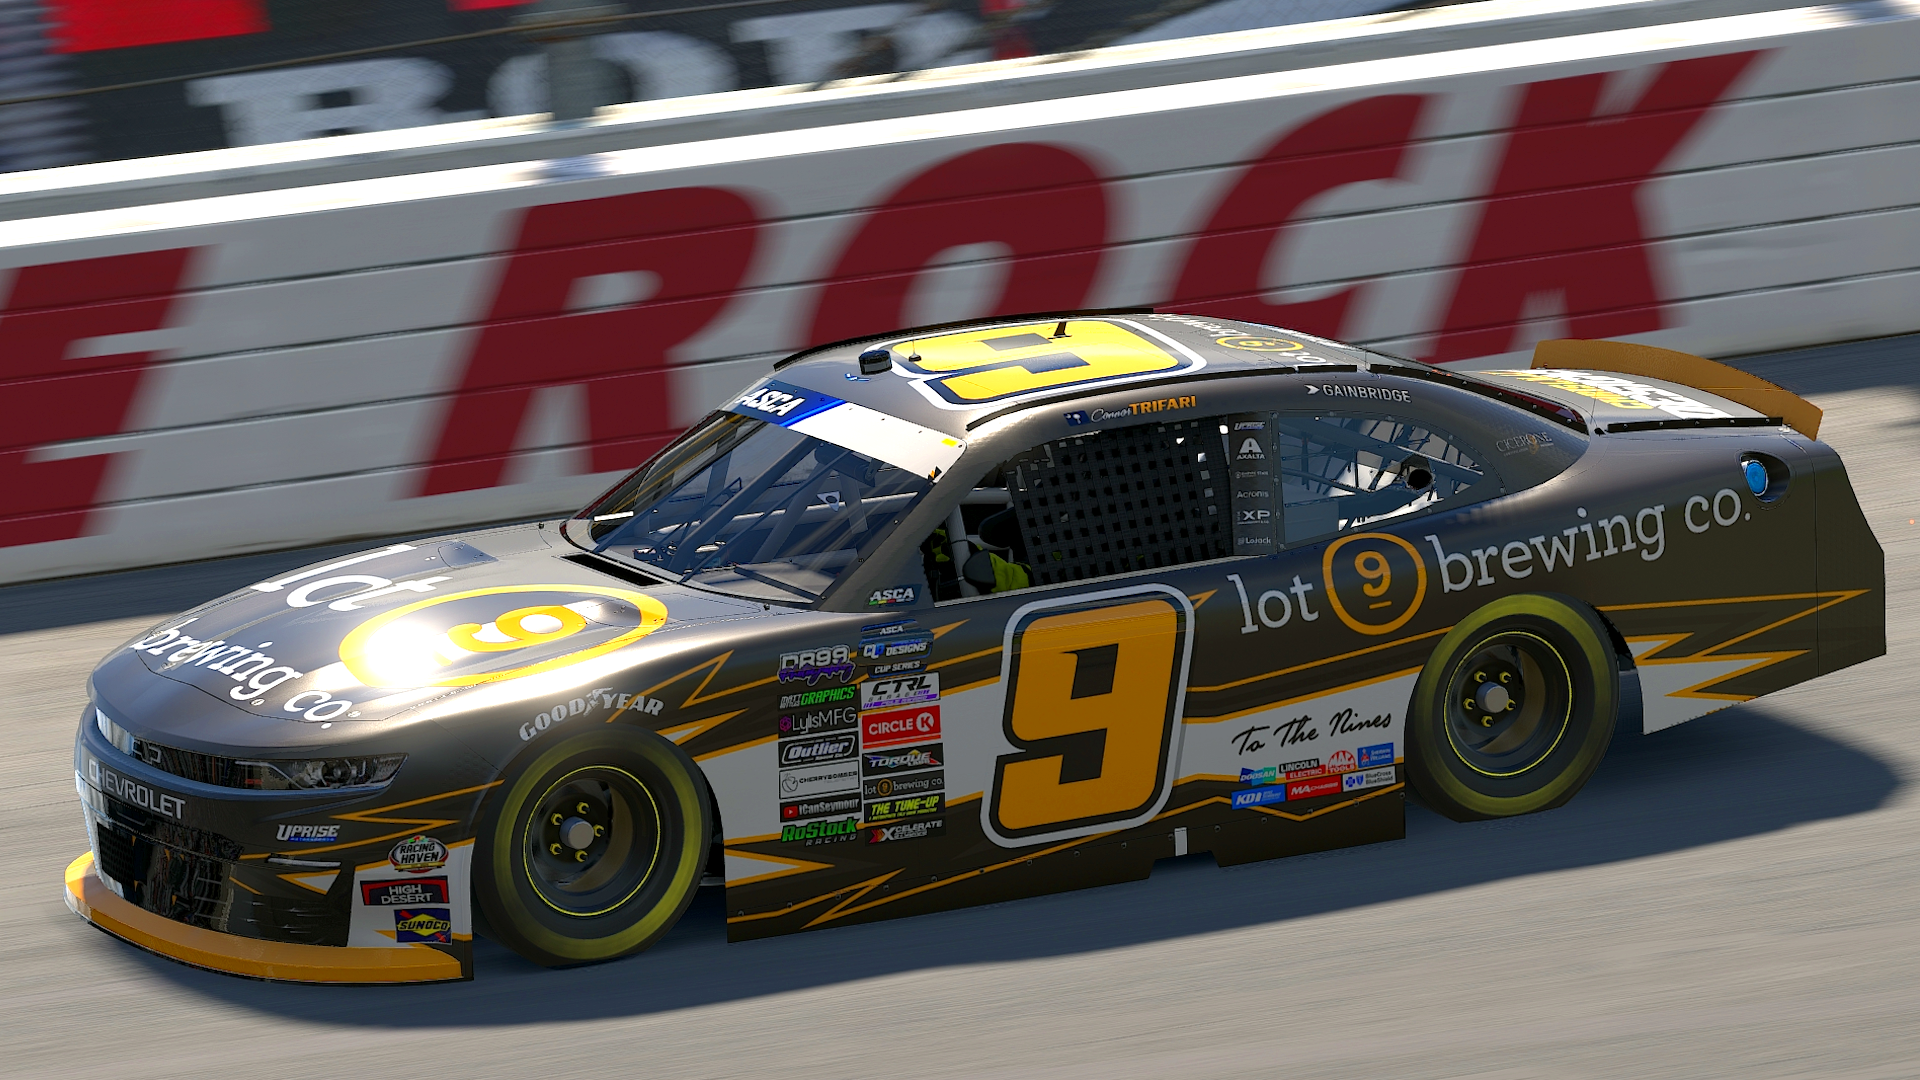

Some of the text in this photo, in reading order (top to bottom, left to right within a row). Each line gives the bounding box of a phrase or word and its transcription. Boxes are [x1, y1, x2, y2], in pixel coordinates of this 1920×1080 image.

[400, 48, 1775, 500] ROCK
[735, 387, 805, 416] ASCA
[1321, 384, 1412, 404] GAINBRIDGE
[1090, 395, 1196, 423] Connor TRIFARI
[1236, 490, 1269, 499] Acronis
[1242, 509, 1271, 521] XP
[1227, 573, 1320, 635] lot
[1425, 504, 1666, 594] brewing
[1684, 487, 1752, 534] co.
[250, 543, 454, 612] lot
[869, 587, 915, 602] ASCA
[880, 625, 904, 635] ASCA
[886, 642, 927, 657] DESIGNS
[134, 617, 304, 702] brewing
[874, 661, 921, 674] CUP SERIES
[872, 675, 932, 696] CTRL
[801, 685, 856, 706] GRAPHICS
[517, 686, 665, 743] GOODYEAR
[992, 594, 1184, 838] 9
[868, 712, 934, 736] CIRCLE K
[1231, 707, 1392, 756] To The Nines
[788, 741, 849, 759] Outlier
[869, 751, 932, 768] TORQUE
[1280, 759, 1319, 774] LINCOLN
[1240, 769, 1275, 782] DOOSAN
[1289, 768, 1323, 779] ELECTRIC
[87, 757, 187, 821] CHEVROLET
[864, 785, 877, 795] lot
[893, 778, 929, 791] brewing
[871, 802, 891, 816] THE
[895, 795, 940, 813] TUNE-UP
[276, 824, 341, 841] UPRISE
[806, 833, 857, 846] RACING
[399, 842, 435, 854] RACING
[401, 851, 439, 864] HAVEN
[388, 884, 422, 895] HIGH
[381, 892, 433, 905] DESERT
[399, 920, 448, 930] SUNOCO
